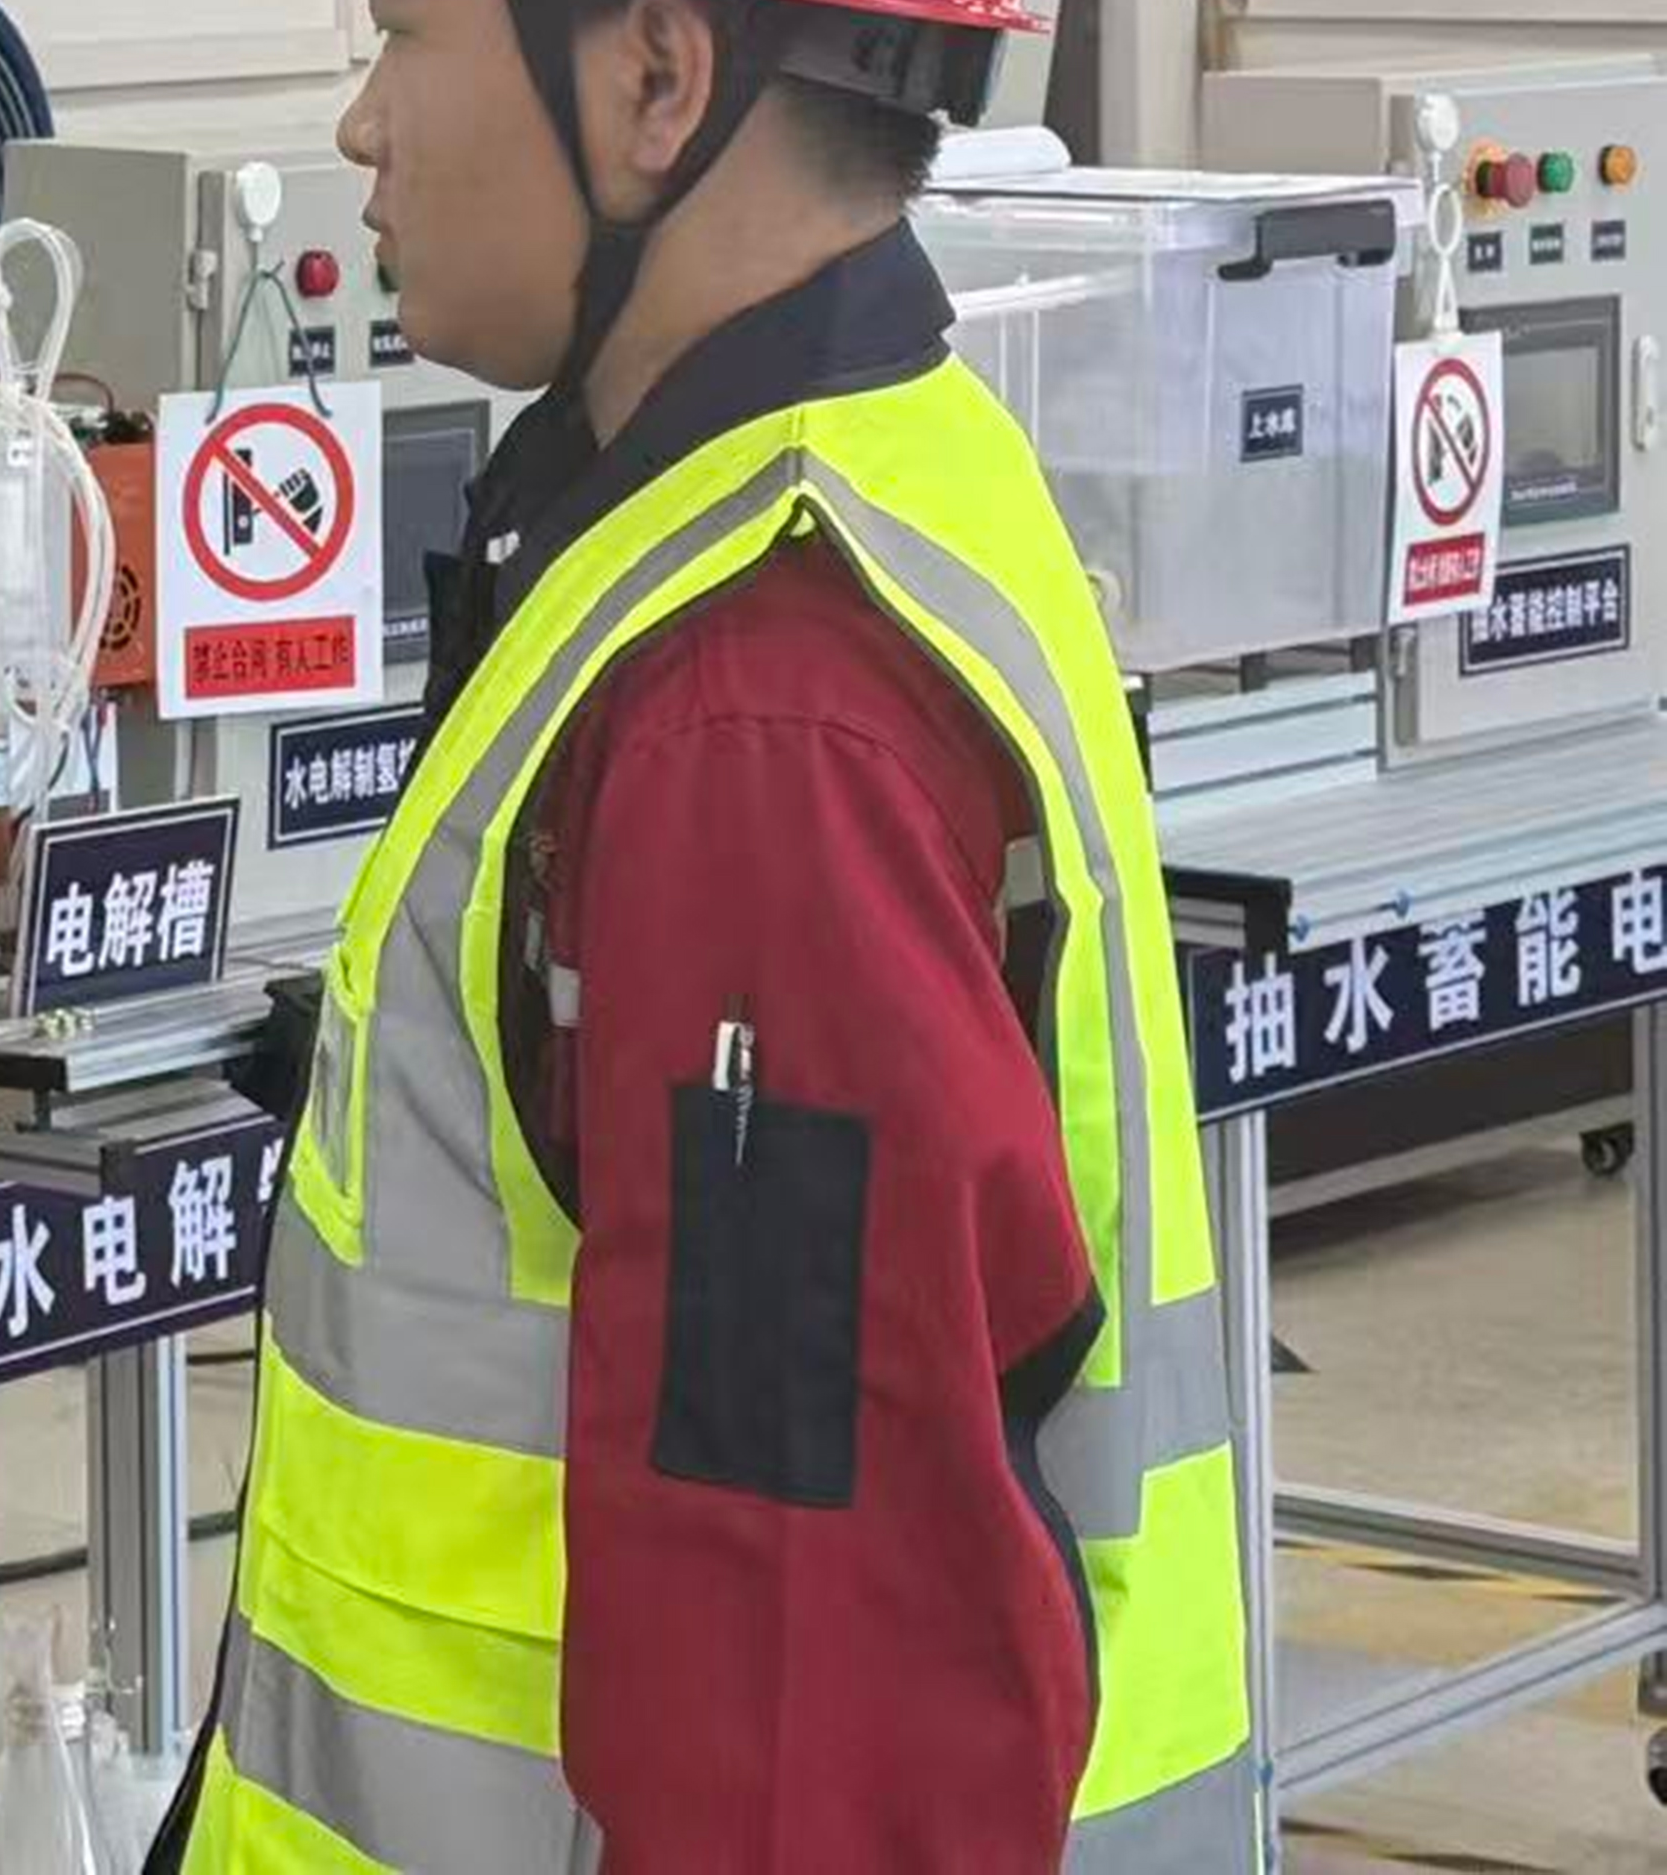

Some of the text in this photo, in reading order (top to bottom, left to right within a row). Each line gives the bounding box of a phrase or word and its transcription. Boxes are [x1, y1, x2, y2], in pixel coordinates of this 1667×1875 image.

[46, 858, 216, 978] 电解槽
[1224, 868, 1667, 1085] 抽水蓄能电
